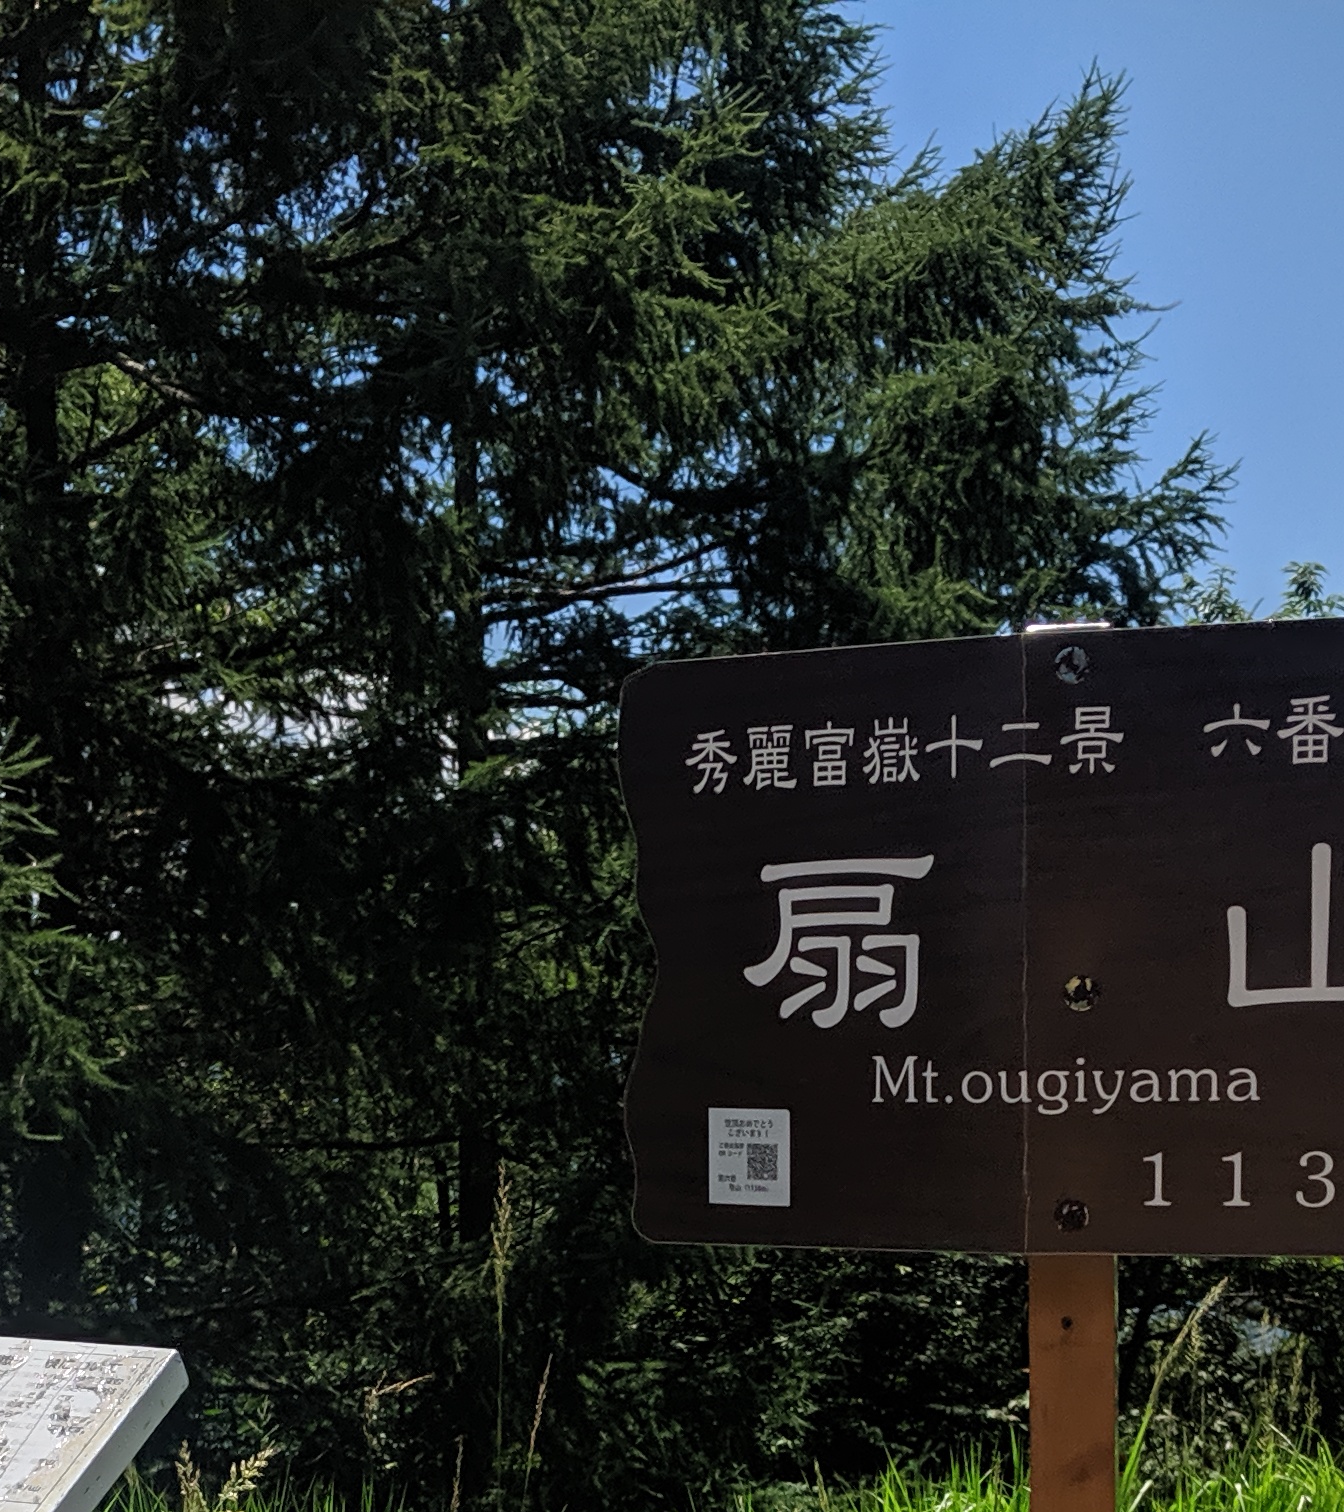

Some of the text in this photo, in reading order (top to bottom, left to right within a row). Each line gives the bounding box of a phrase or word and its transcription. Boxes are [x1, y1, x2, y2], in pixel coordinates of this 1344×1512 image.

[684, 704, 1125, 795] 秀麗富嶽十二景
[870, 1055, 1262, 1116] Mt.ougiyama
